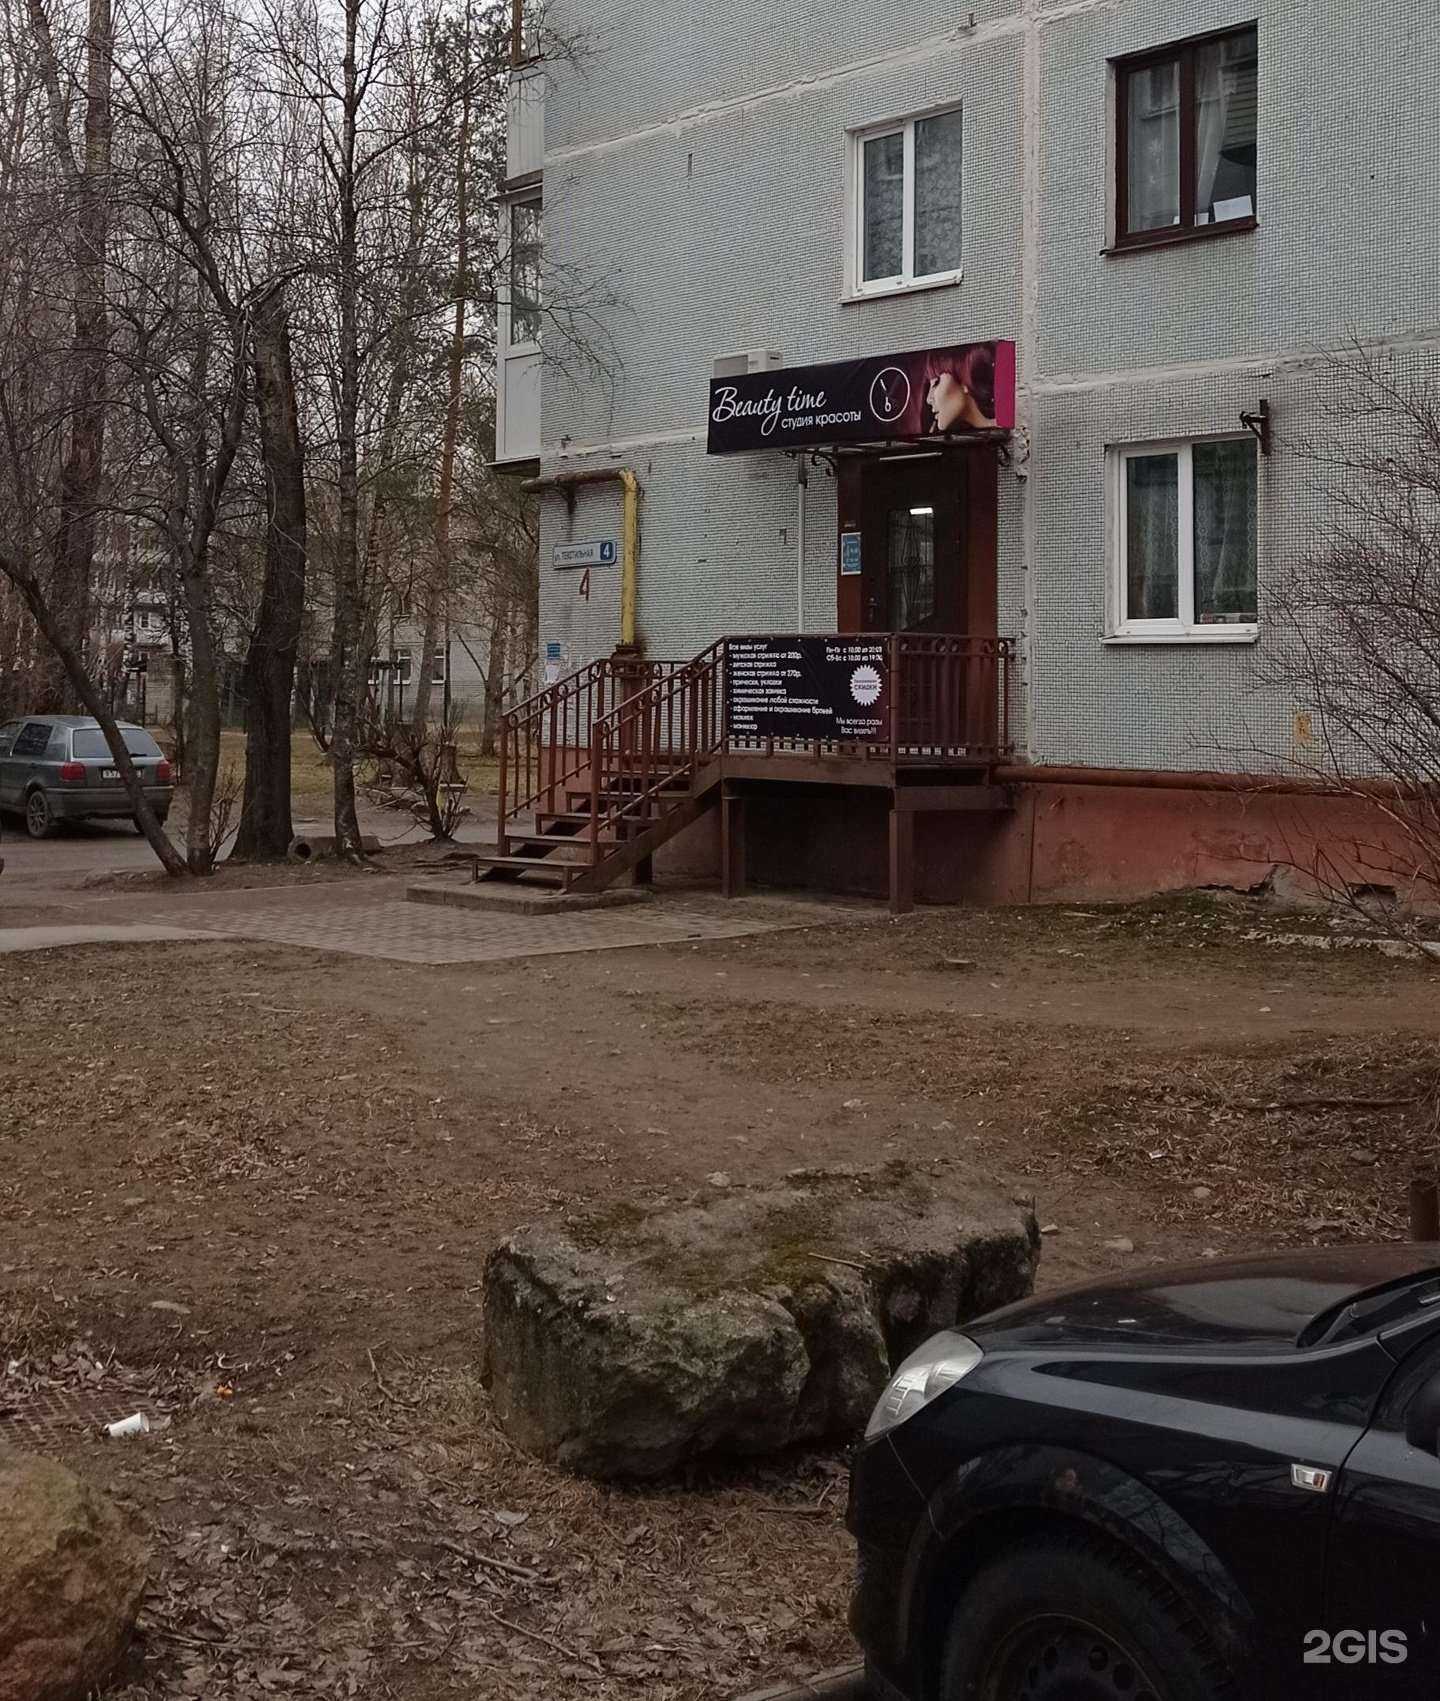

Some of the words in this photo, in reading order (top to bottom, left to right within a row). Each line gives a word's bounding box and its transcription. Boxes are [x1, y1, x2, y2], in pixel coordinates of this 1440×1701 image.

[712, 387, 782, 436] Beauty
[787, 386, 827, 411] time
[781, 415, 814, 430] студия
[815, 410, 862, 427] красоты
[579, 567, 589, 602] 4
[753, 643, 768, 651] услуг
[812, 706, 833, 715] бровей
[866, 718, 883, 726] рады
[841, 726, 853, 734] Вас
